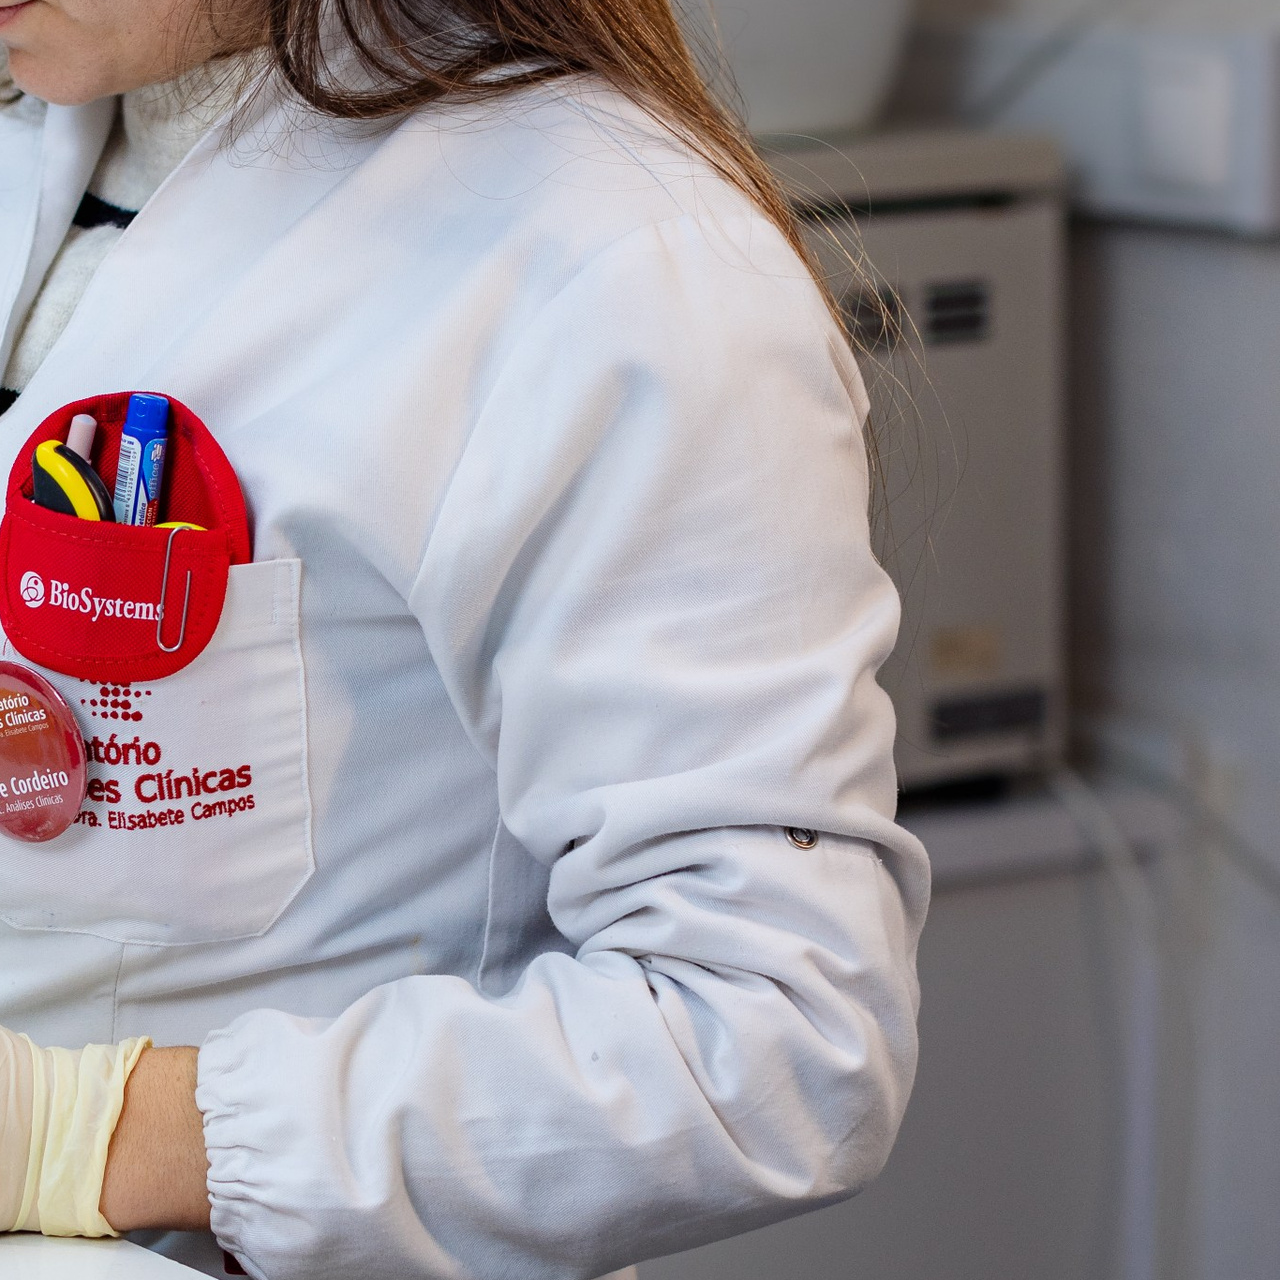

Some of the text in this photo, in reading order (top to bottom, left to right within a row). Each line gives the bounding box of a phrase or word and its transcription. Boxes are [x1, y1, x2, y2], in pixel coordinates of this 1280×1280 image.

[138, 502, 146, 526] etálica
[49, 579, 165, 622] BioSystems
[4, 725, 27, 737] Elisabete
[27, 722, 49, 734] Campos
[5, 708, 47, 727] Clínicas
[10, 768, 69, 796] Cordeiro
[134, 765, 253, 804] Clínicas
[6, 799, 35, 813] Análises
[35, 793, 64, 808] Clínicas
[108, 808, 185, 831] Elisabete
[190, 794, 256, 818] Campos
